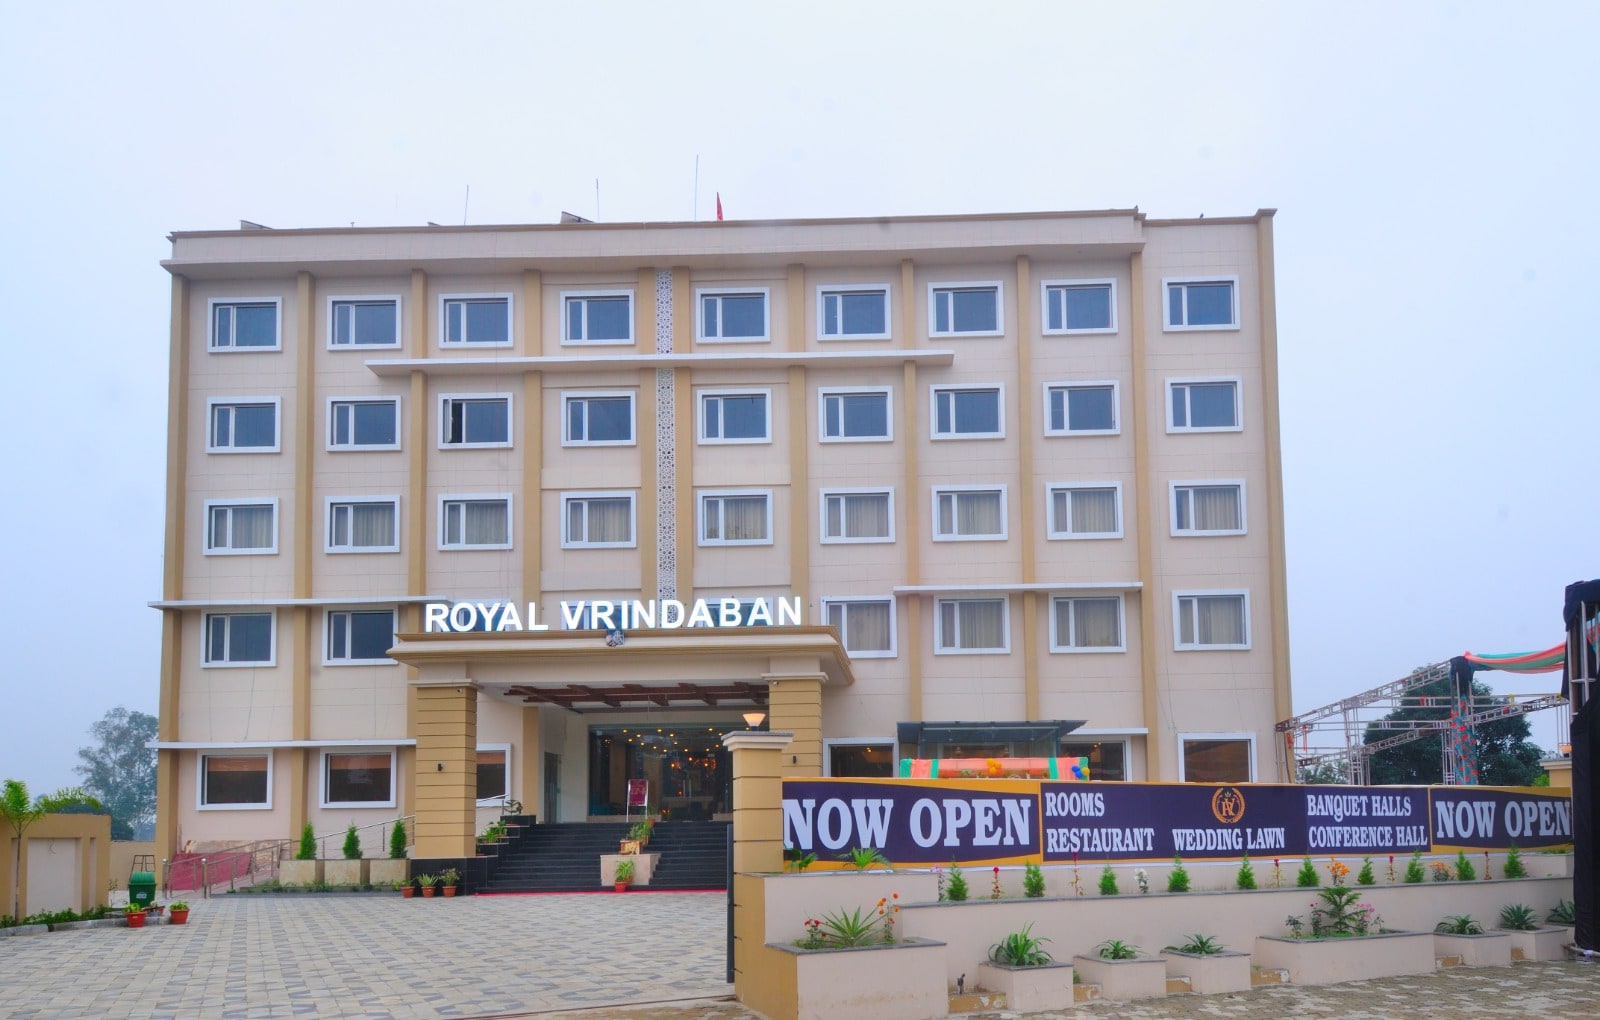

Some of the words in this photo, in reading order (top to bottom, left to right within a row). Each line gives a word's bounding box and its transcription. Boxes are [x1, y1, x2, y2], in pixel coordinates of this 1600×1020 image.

[425, 602, 549, 632] ROYAL
[560, 596, 801, 630] VRINDABAN
[1045, 792, 1105, 817] ROOMS
[1306, 794, 1369, 823] BANQUET
[1371, 795, 1412, 817] HALLS
[782, 798, 894, 850] NOW
[909, 798, 1032, 848] OPEN
[1435, 801, 1496, 838] NOW
[1504, 800, 1571, 838] OPEN
[1046, 827, 1155, 853] RESTAURANT
[1171, 828, 1243, 852] WEDDING
[1245, 827, 1285, 850] LAWN
[1308, 825, 1393, 848] CONFERENCE
[1395, 825, 1428, 847] HALL
